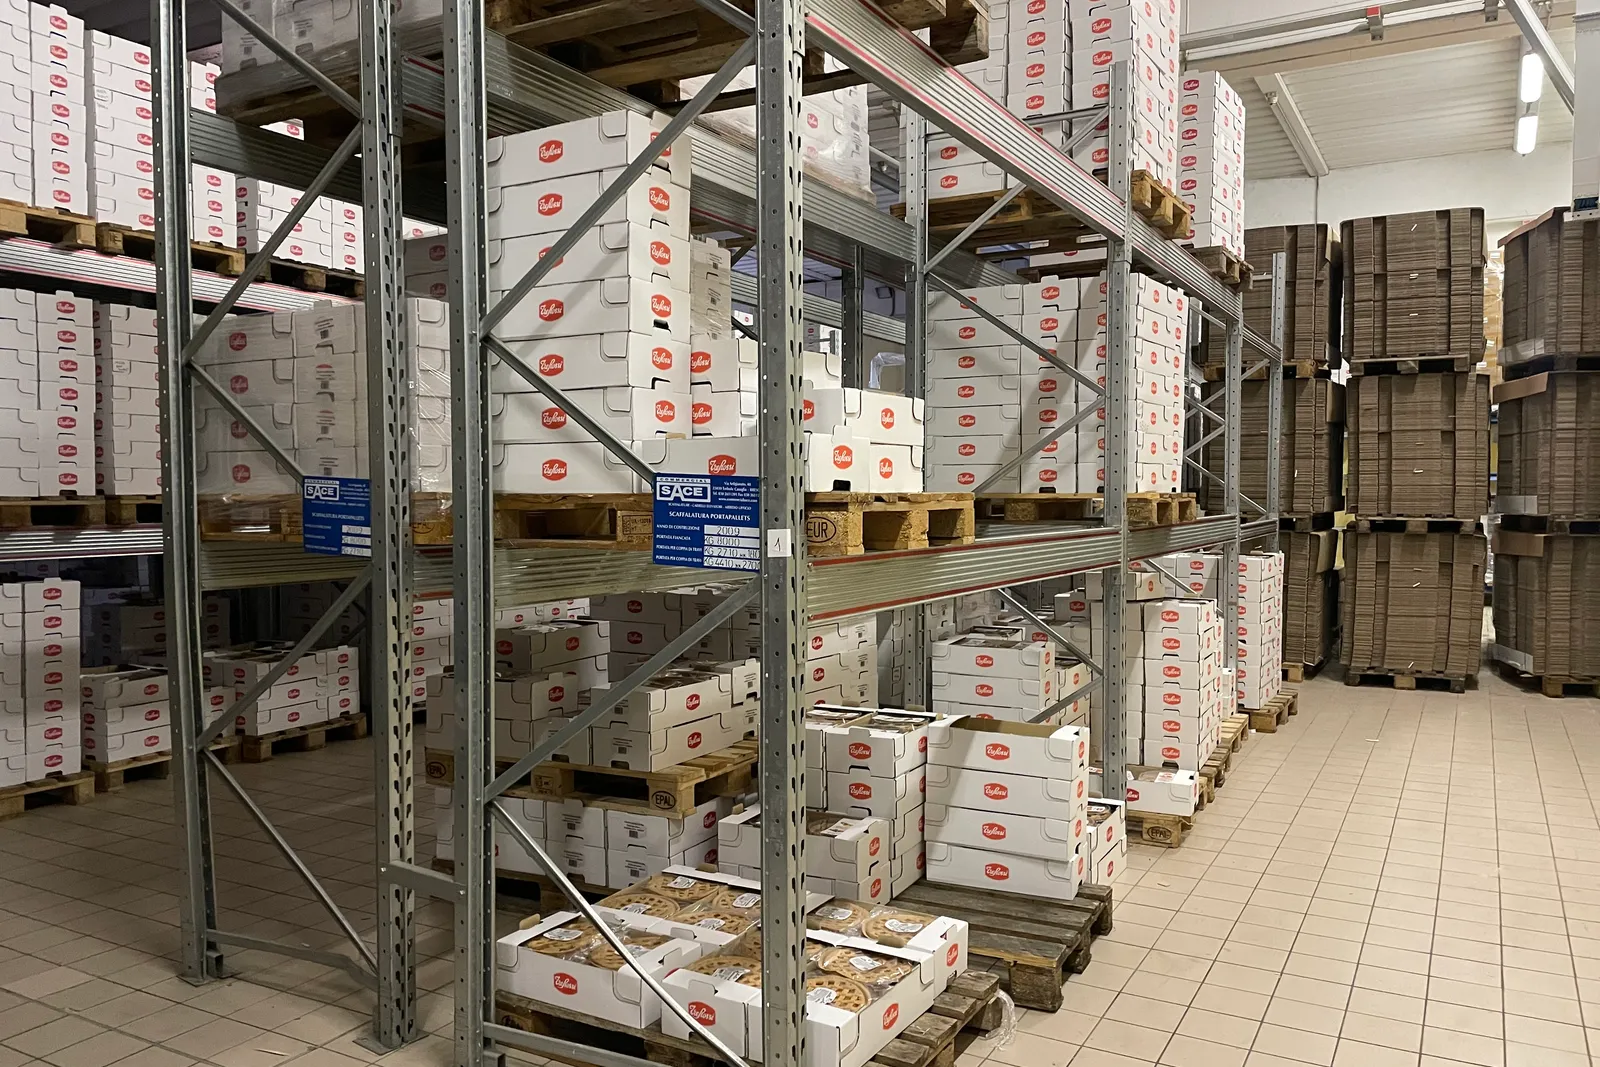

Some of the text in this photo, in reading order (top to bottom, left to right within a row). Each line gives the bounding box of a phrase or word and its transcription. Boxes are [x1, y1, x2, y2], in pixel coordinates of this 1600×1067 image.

[307, 485, 335, 499] SACE
[661, 484, 703, 500] SACE
[669, 511, 751, 521] SCAFFALATURA PORTAPALLETS
[717, 526, 740, 536] 2009
[806, 521, 828, 538] EUR
[717, 537, 740, 546] 8000
[718, 548, 738, 557] 2710
[715, 559, 734, 568] 4410
[655, 794, 673, 806] EPAL
